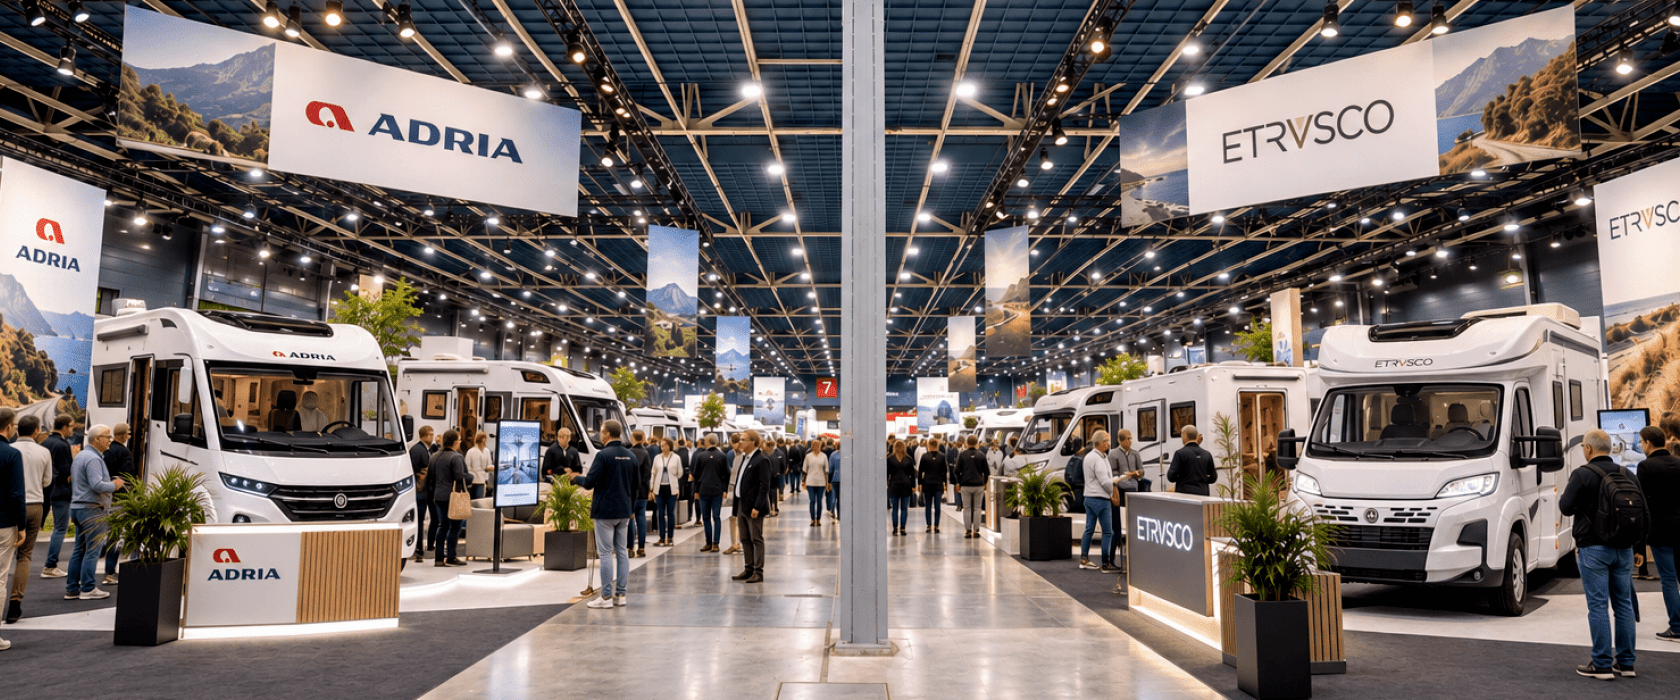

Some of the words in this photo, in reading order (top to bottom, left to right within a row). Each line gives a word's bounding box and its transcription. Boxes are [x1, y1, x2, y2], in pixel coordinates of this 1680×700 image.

[368, 112, 523, 164] ADRIA
[15, 245, 81, 273] ADRIA
[289, 351, 336, 361] ADRIA
[822, 381, 832, 394] 7
[207, 564, 281, 581] ADRIA
